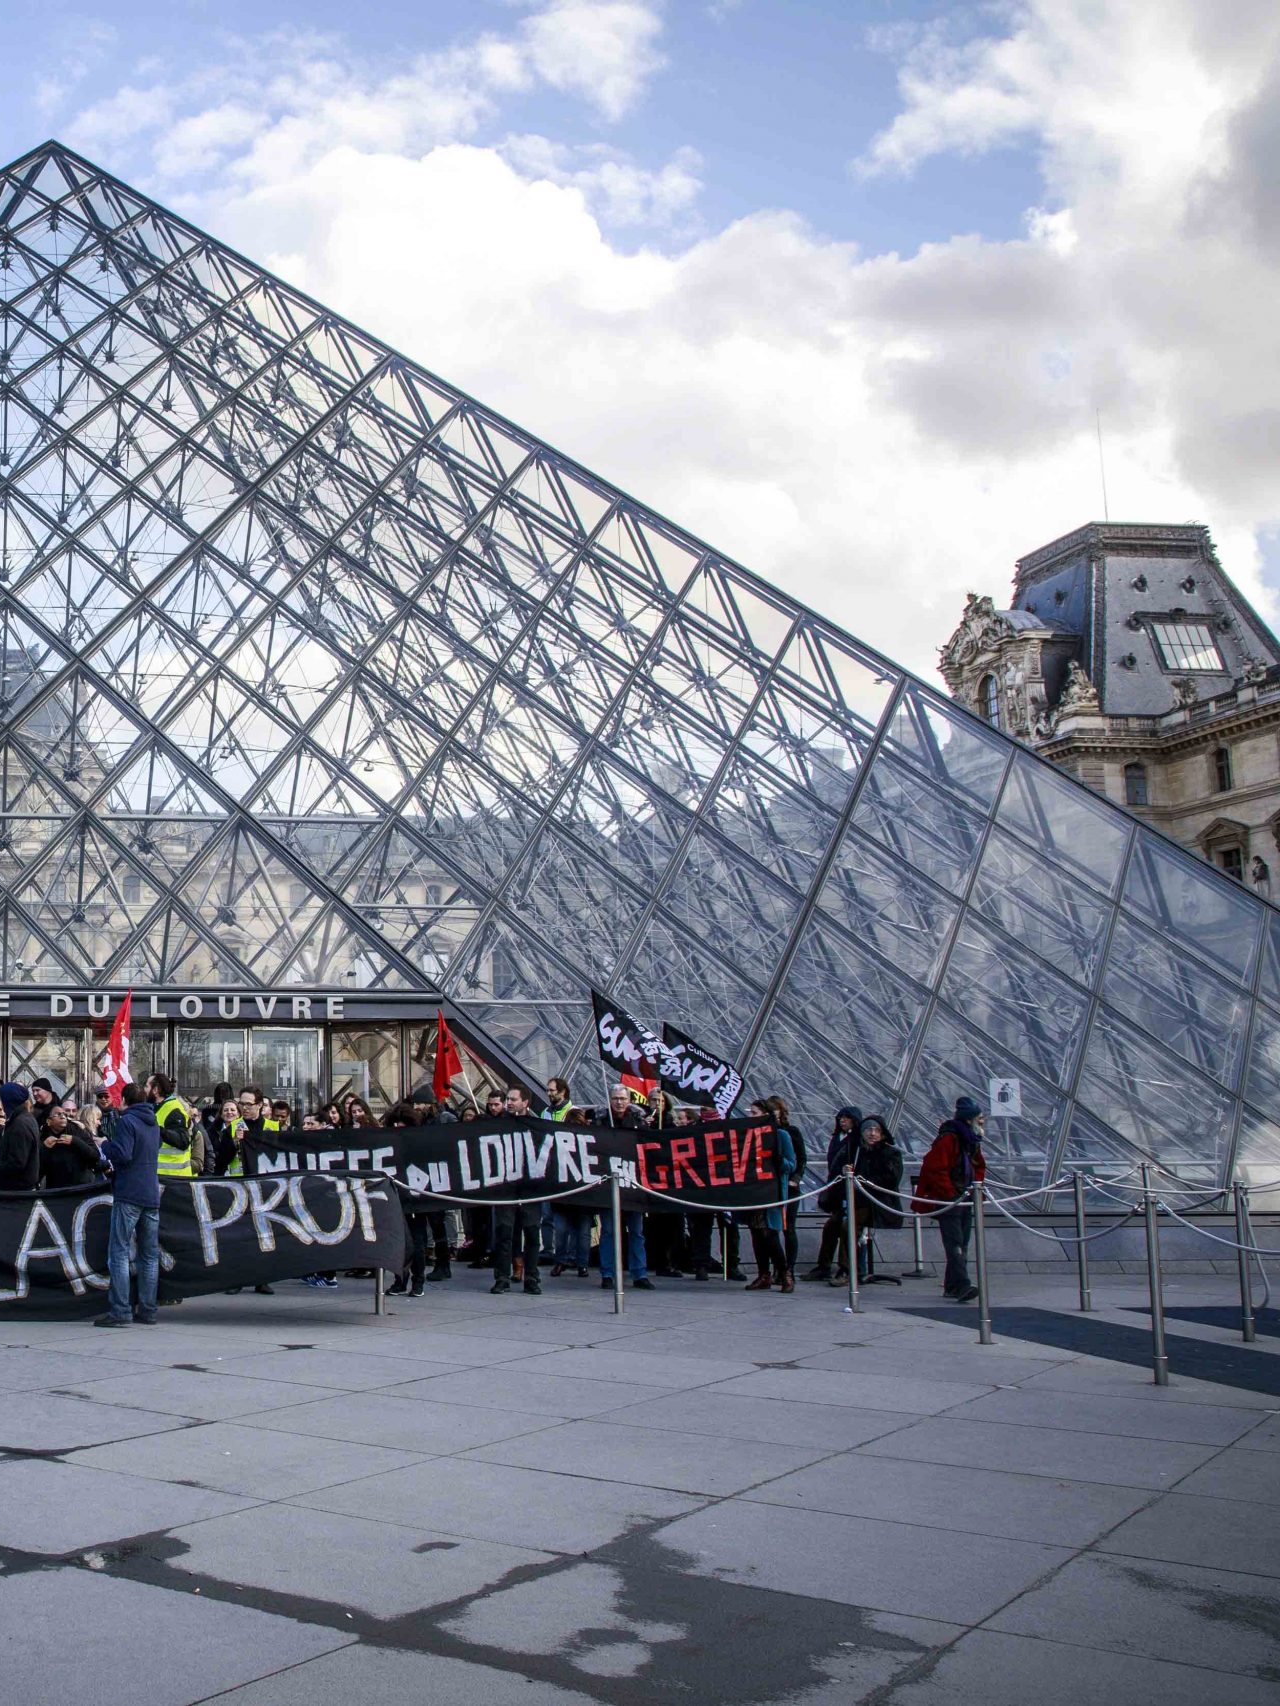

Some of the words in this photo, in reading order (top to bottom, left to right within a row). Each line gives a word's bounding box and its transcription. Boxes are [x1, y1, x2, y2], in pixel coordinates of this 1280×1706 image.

[50, 994, 110, 1018] DU
[150, 995, 345, 1020] LOUVRE
[686, 1043, 720, 1066] Culture
[406, 1161, 451, 1196] DU
[458, 1131, 603, 1191] LOUVRE
[636, 1124, 776, 1190] GREVE
[189, 1174, 389, 1268] PROF
